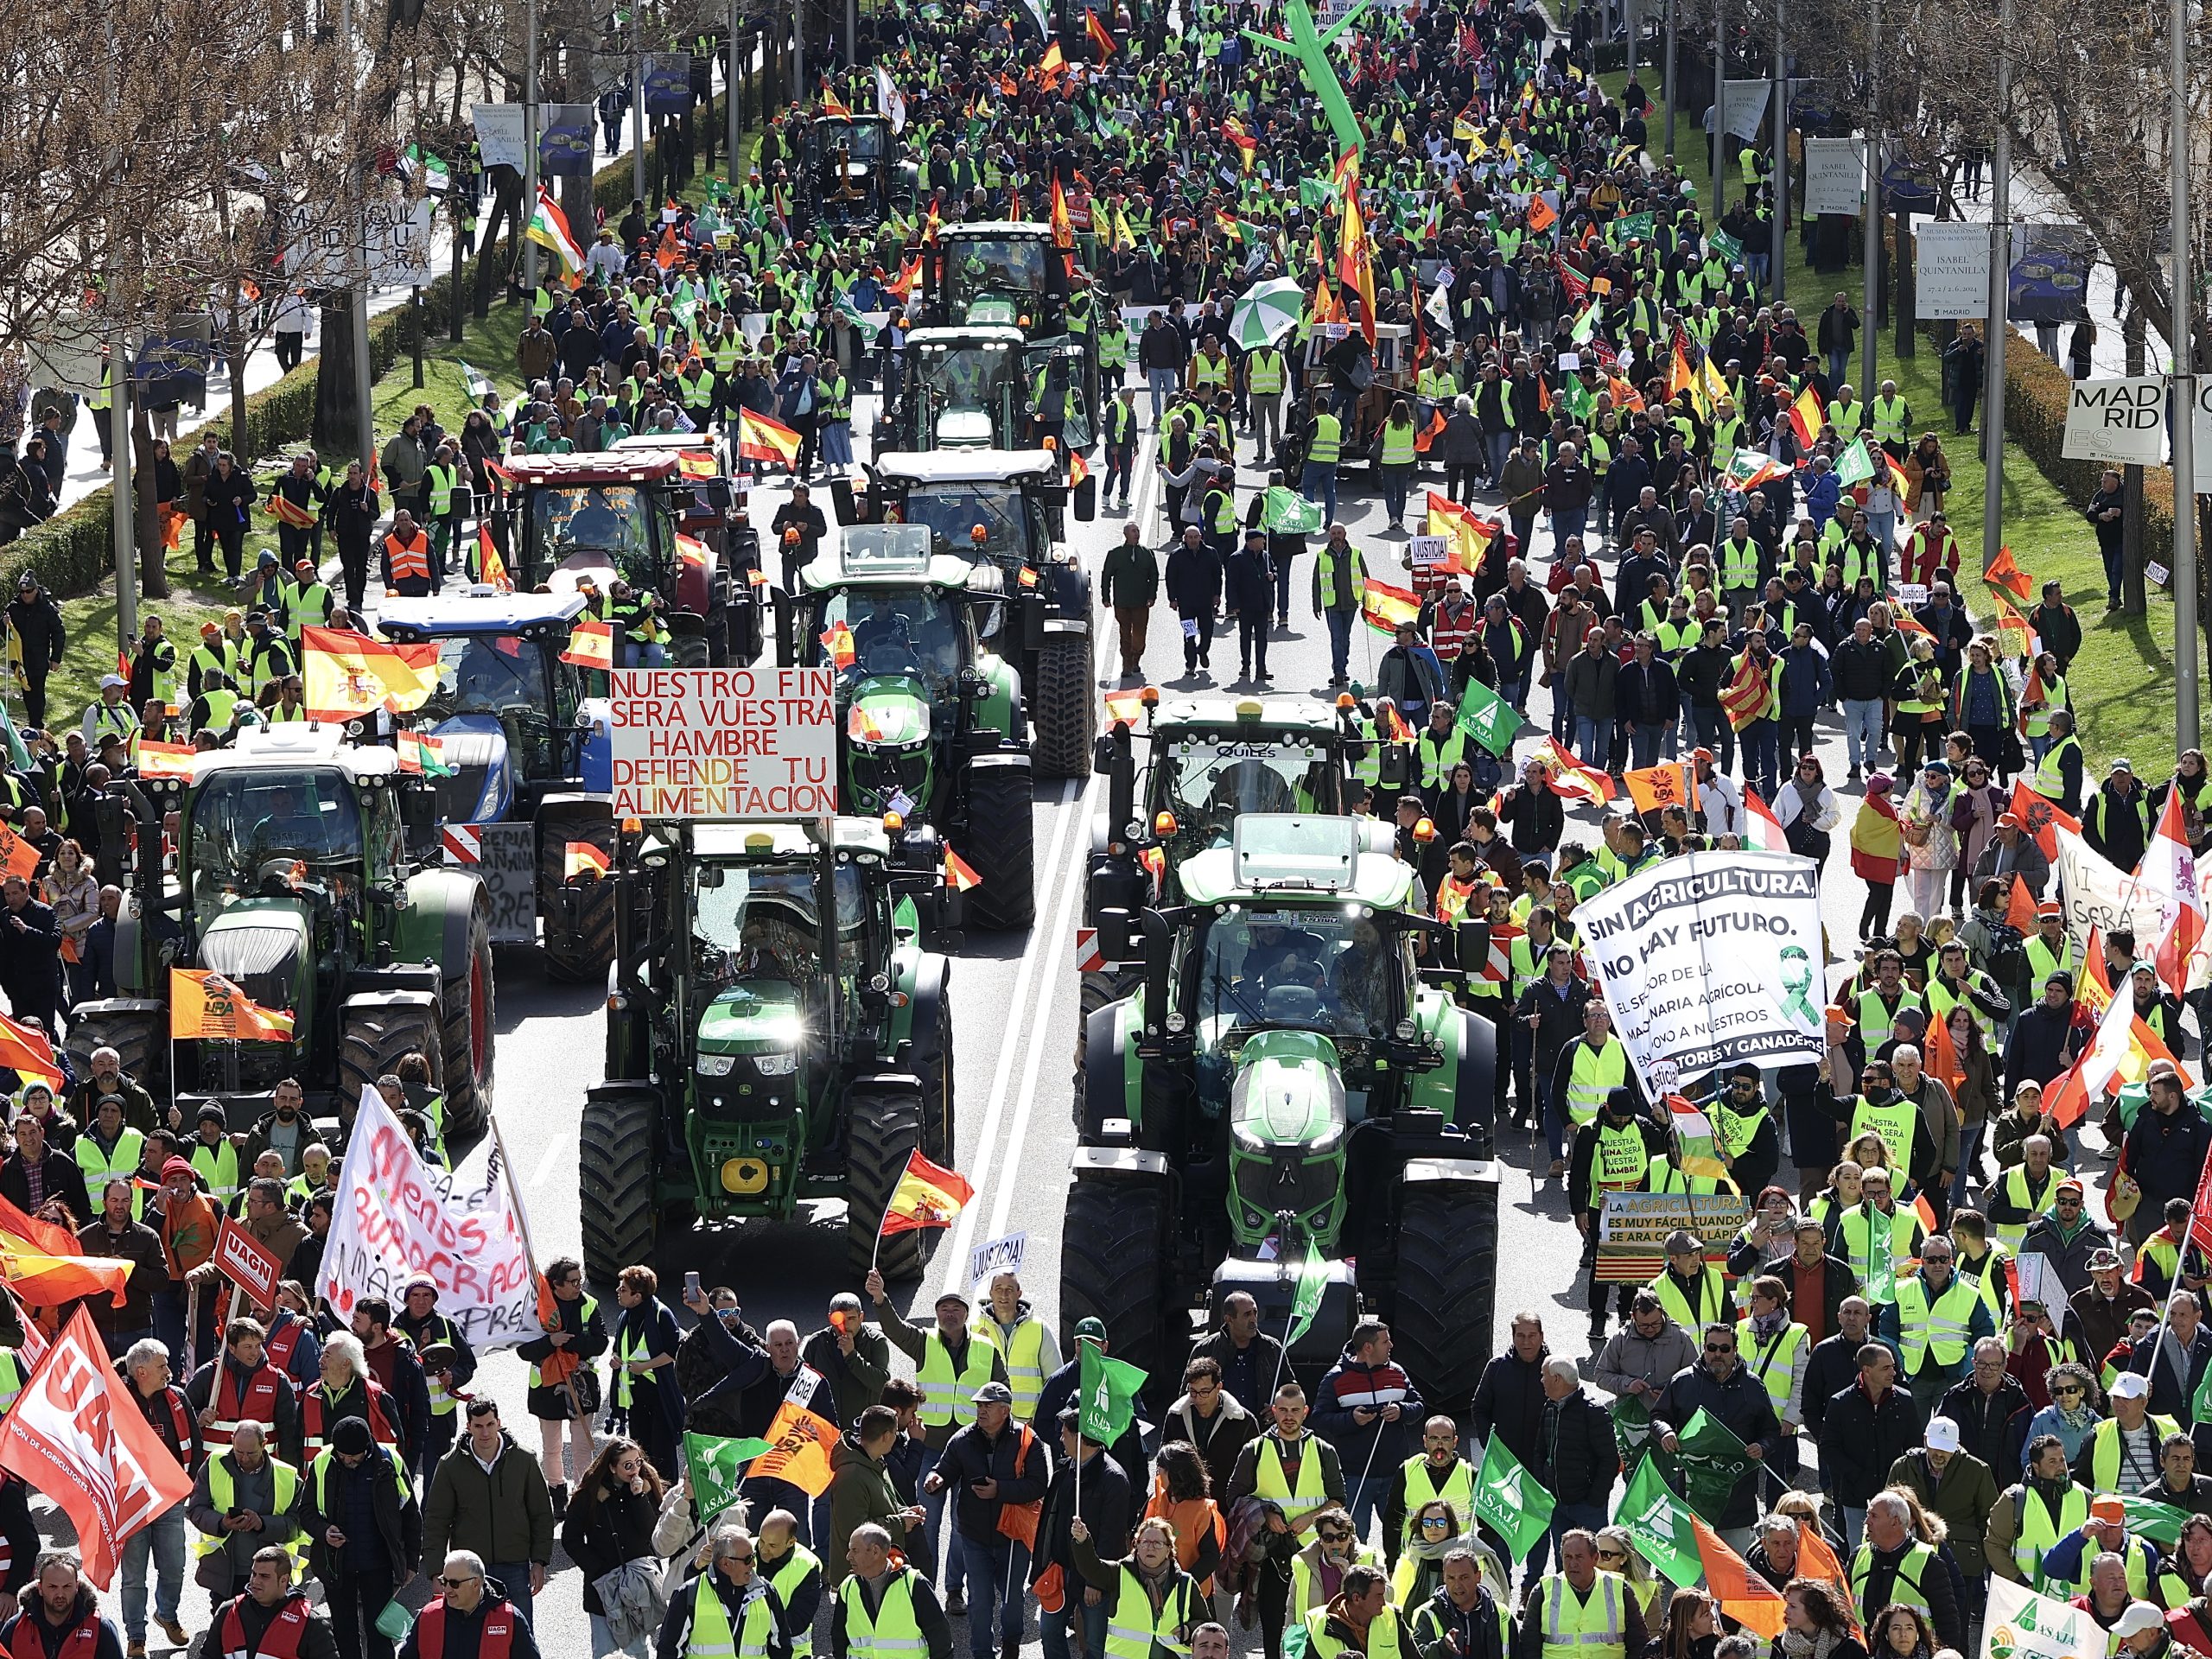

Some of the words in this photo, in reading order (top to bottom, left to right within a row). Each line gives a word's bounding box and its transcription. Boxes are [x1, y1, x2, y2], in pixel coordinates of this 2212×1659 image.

[1919, 267, 1986, 276] QUINTANILLA
[2075, 385, 2161, 408] MAD
[2104, 409, 2159, 429] RID
[2070, 429, 2112, 448] ES
[734, 478, 753, 490] usticia!
[1413, 539, 1447, 558] ¡JUSTICIA!
[1900, 588, 1927, 601] Justicia!
[612, 671, 754, 698] NUESTRO
[779, 671, 832, 696] FIN
[612, 701, 688, 728] SERA
[699, 698, 836, 727] VUESTRA
[1463, 717, 1493, 742] ASAJA
[650, 729, 778, 756] HAMBRE
[1217, 746, 1276, 758] QUILES
[613, 758, 749, 785] DEFIENDE
[782, 756, 827, 783] TU
[614, 785, 837, 815] ALIMENTACION
[1654, 788, 1675, 801] UPA
[1588, 912, 1624, 941] SIN
[1630, 868, 1816, 927] AGRICULTURA,
[1602, 955, 1635, 982] NO
[1689, 912, 1797, 944] FUTURO.
[1617, 1001, 1630, 1015] EL
[1630, 974, 1668, 1010] SEOR
[1672, 967, 1694, 982] DE
[1699, 962, 1713, 976] LA
[202, 1001, 235, 1016] UPA
[1637, 1052, 1651, 1068] EN
[1680, 1027, 1691, 1039] A
[1694, 1009, 1770, 1034] NUESTROS
[1723, 1045, 1733, 1057] Y
[1603, 1137, 1636, 1147] NUESTRA
[1884, 1128, 1904, 1139] SERÁ
[1624, 1145, 1642, 1155] SERÁ
[1605, 1164, 1638, 1175] HAMBRE
[369, 1126, 486, 1256] Menos
[1609, 1202, 1624, 1212] LA
[1626, 1197, 1743, 1213] AGRICULTURA
[1608, 1218, 1622, 1228] ES
[1625, 1217, 1651, 1229] MUY
[1654, 1214, 1688, 1228] FÁCIL
[1690, 1214, 1743, 1226] CUANDO
[1609, 1231, 1623, 1241] SE
[1626, 1230, 1651, 1241] ARA
[1707, 1228, 1739, 1241] LÁPIZ
[228, 1235, 273, 1281] UAGN
[972, 1237, 1025, 1281] ¡JUSTICIA!
[2024, 1253, 2037, 1262] NO
[790, 1371, 818, 1402] icia!
[29, 1437, 41, 1450] DE
[40, 1447, 89, 1492] AGRICULTORES
[1498, 1519, 1514, 1538] Mancha
[1628, 1521, 1677, 1561] ASAJA
[1649, 1546, 1667, 1564] Mancha
[2037, 1624, 2075, 1646] ASAJA
